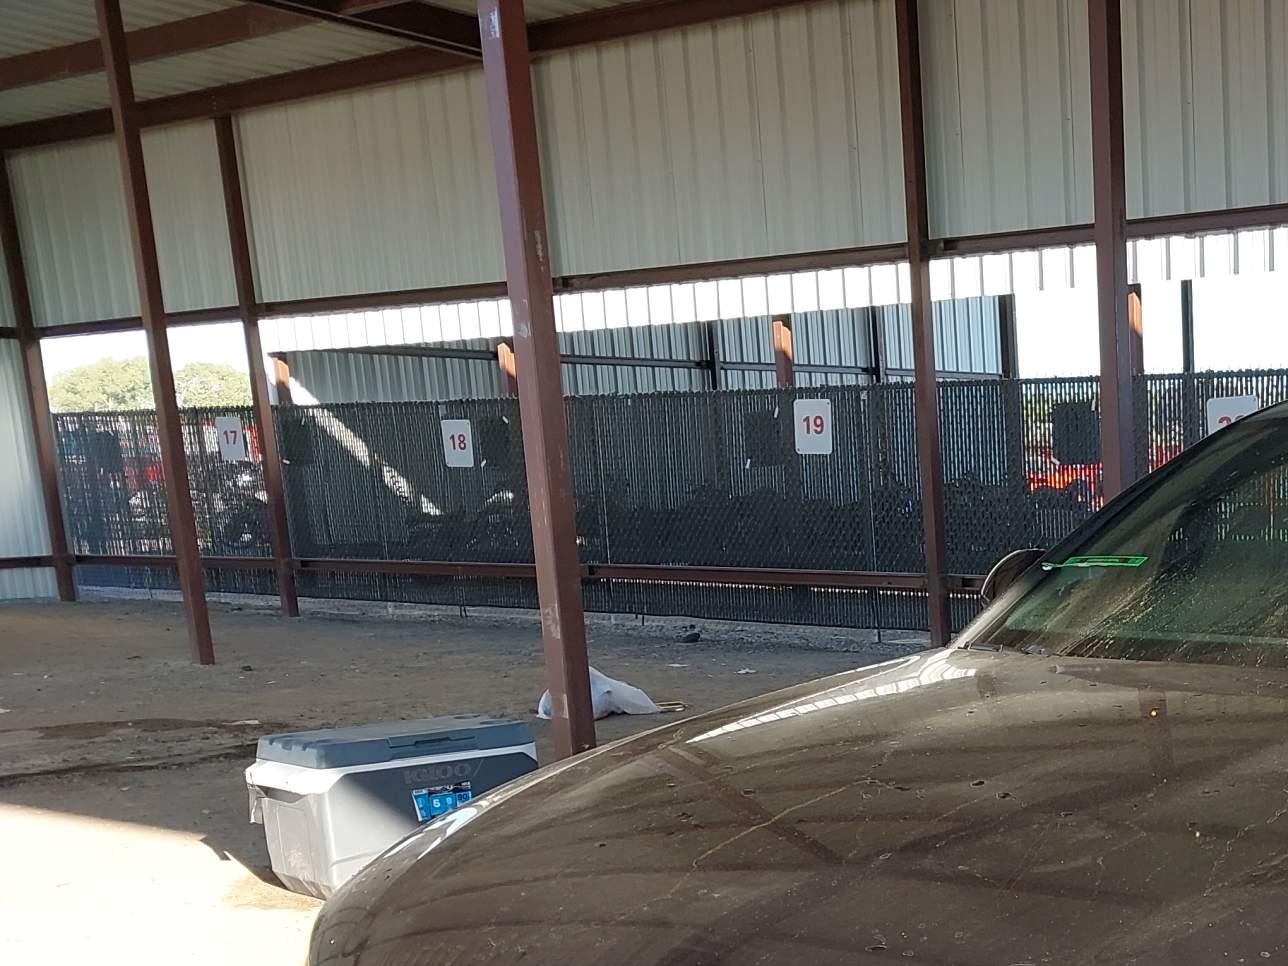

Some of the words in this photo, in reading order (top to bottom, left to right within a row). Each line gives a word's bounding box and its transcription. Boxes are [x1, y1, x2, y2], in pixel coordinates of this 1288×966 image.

[802, 415, 825, 435] 19
[223, 430, 237, 445] 17
[449, 434, 467, 451] 18
